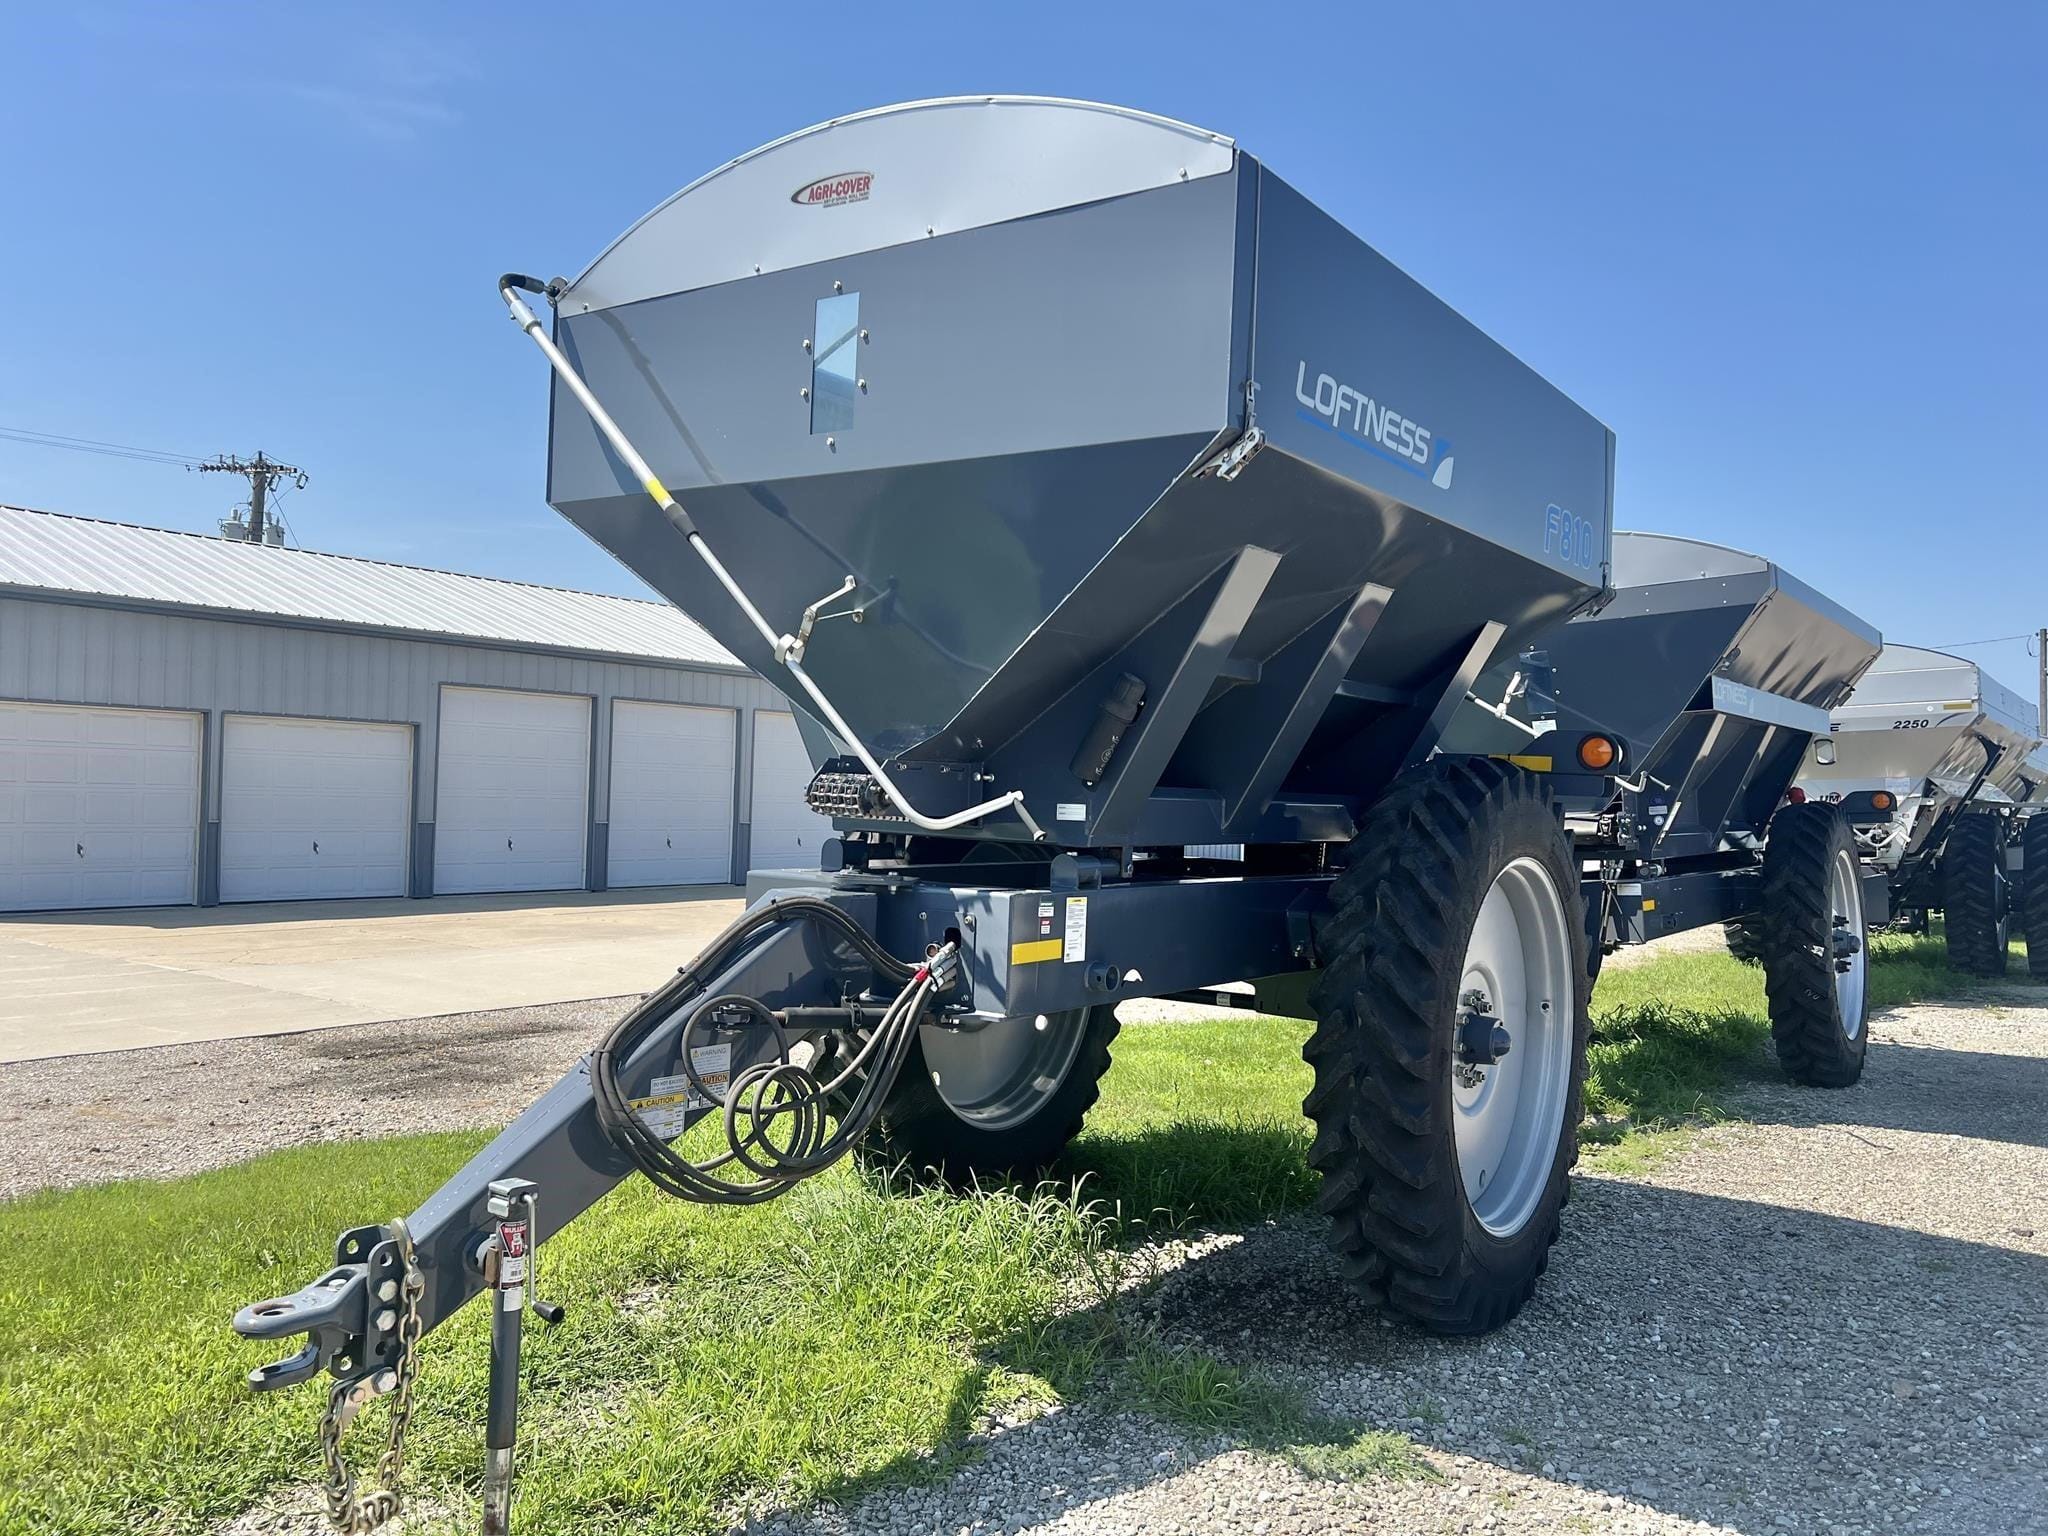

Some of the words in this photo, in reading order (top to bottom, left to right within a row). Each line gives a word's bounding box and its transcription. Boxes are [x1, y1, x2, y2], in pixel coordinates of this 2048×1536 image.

[808, 175, 870, 202] AGRI-COVER
[1296, 360, 1431, 465] LOFTNESS
[1544, 503, 1593, 570] F810
[1893, 719, 1929, 729] 2250
[700, 1047, 727, 1057] WARNING
[702, 1074, 727, 1085] AUTION
[646, 1096, 674, 1107] CAUTION
